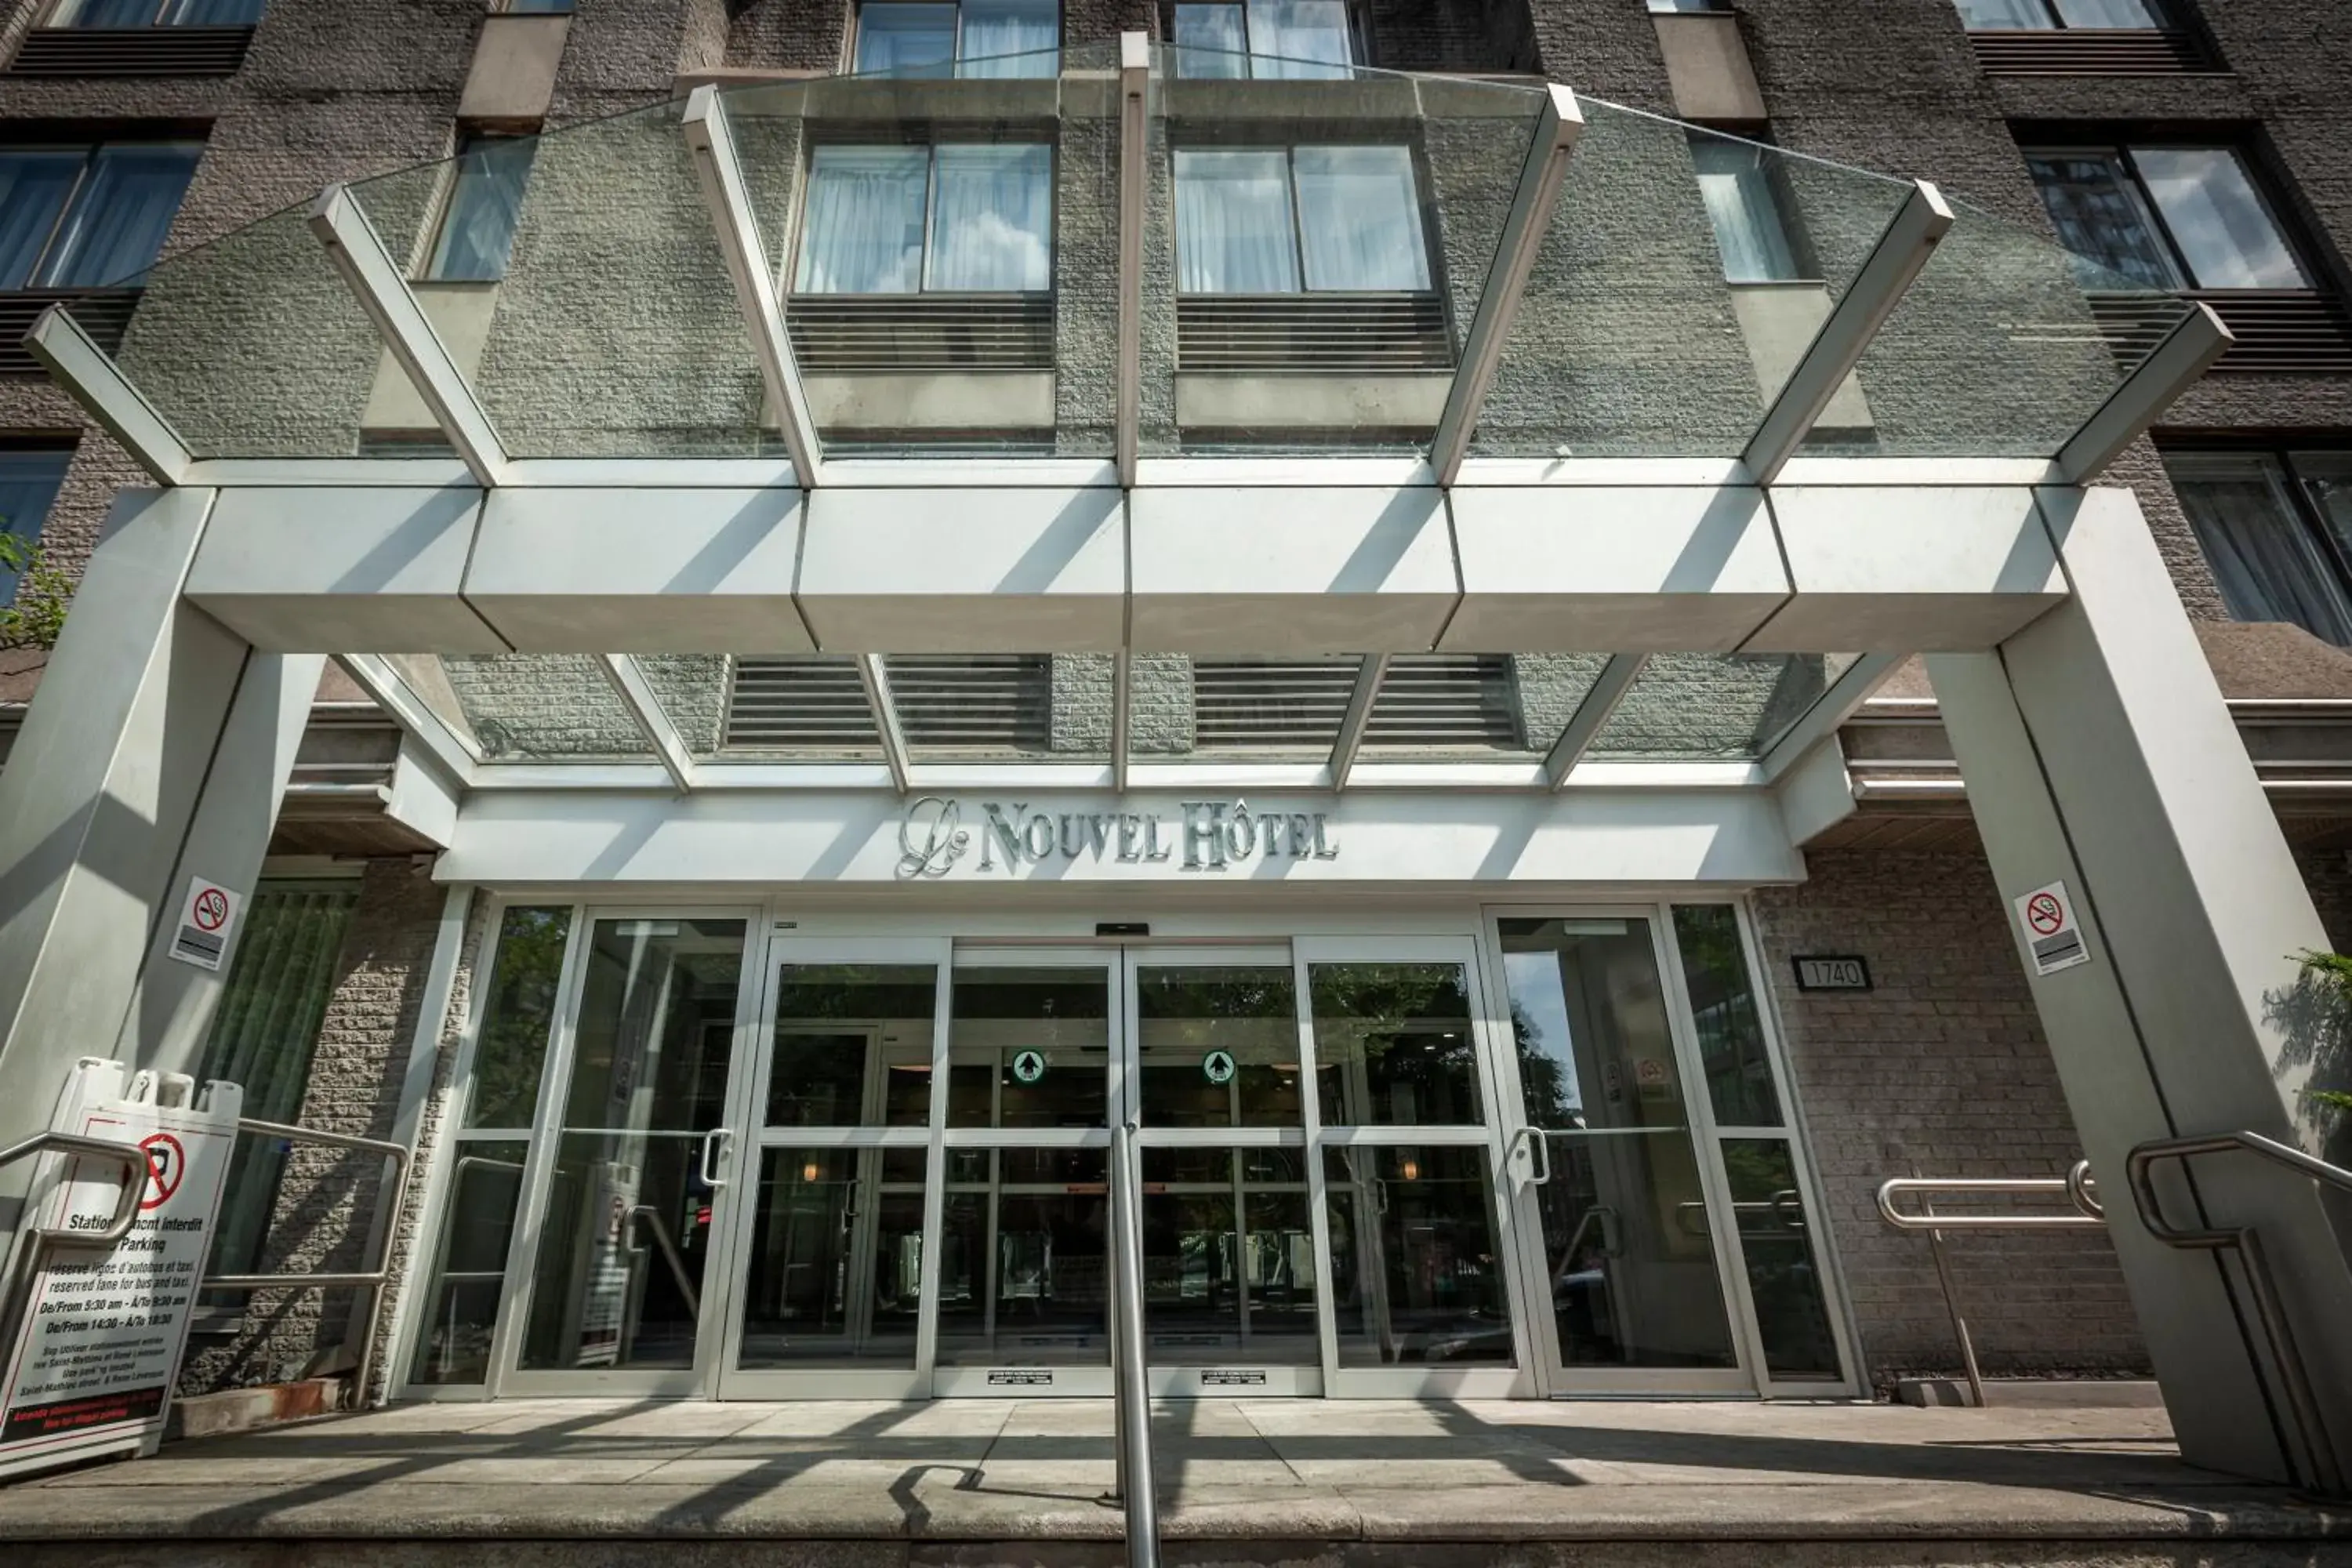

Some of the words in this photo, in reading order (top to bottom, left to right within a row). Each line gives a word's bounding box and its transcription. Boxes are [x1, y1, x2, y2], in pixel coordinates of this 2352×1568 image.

[897, 796, 971, 876] Le
[979, 802, 1171, 869] NOUVEL
[1179, 798, 1339, 868] HÔTEL
[1809, 963, 1860, 984] 1740
[162, 1217, 203, 1231] interdit
[120, 1236, 166, 1254] Parking
[49, 1279, 95, 1293] reserved
[120, 1278, 134, 1290] for
[135, 1277, 152, 1289] bus
[40, 1300, 82, 1315] De/From
[84, 1299, 107, 1311] 5:30
[107, 1301, 123, 1310] am
[45, 1320, 89, 1334] De/From
[90, 1318, 118, 1330] 14:30
